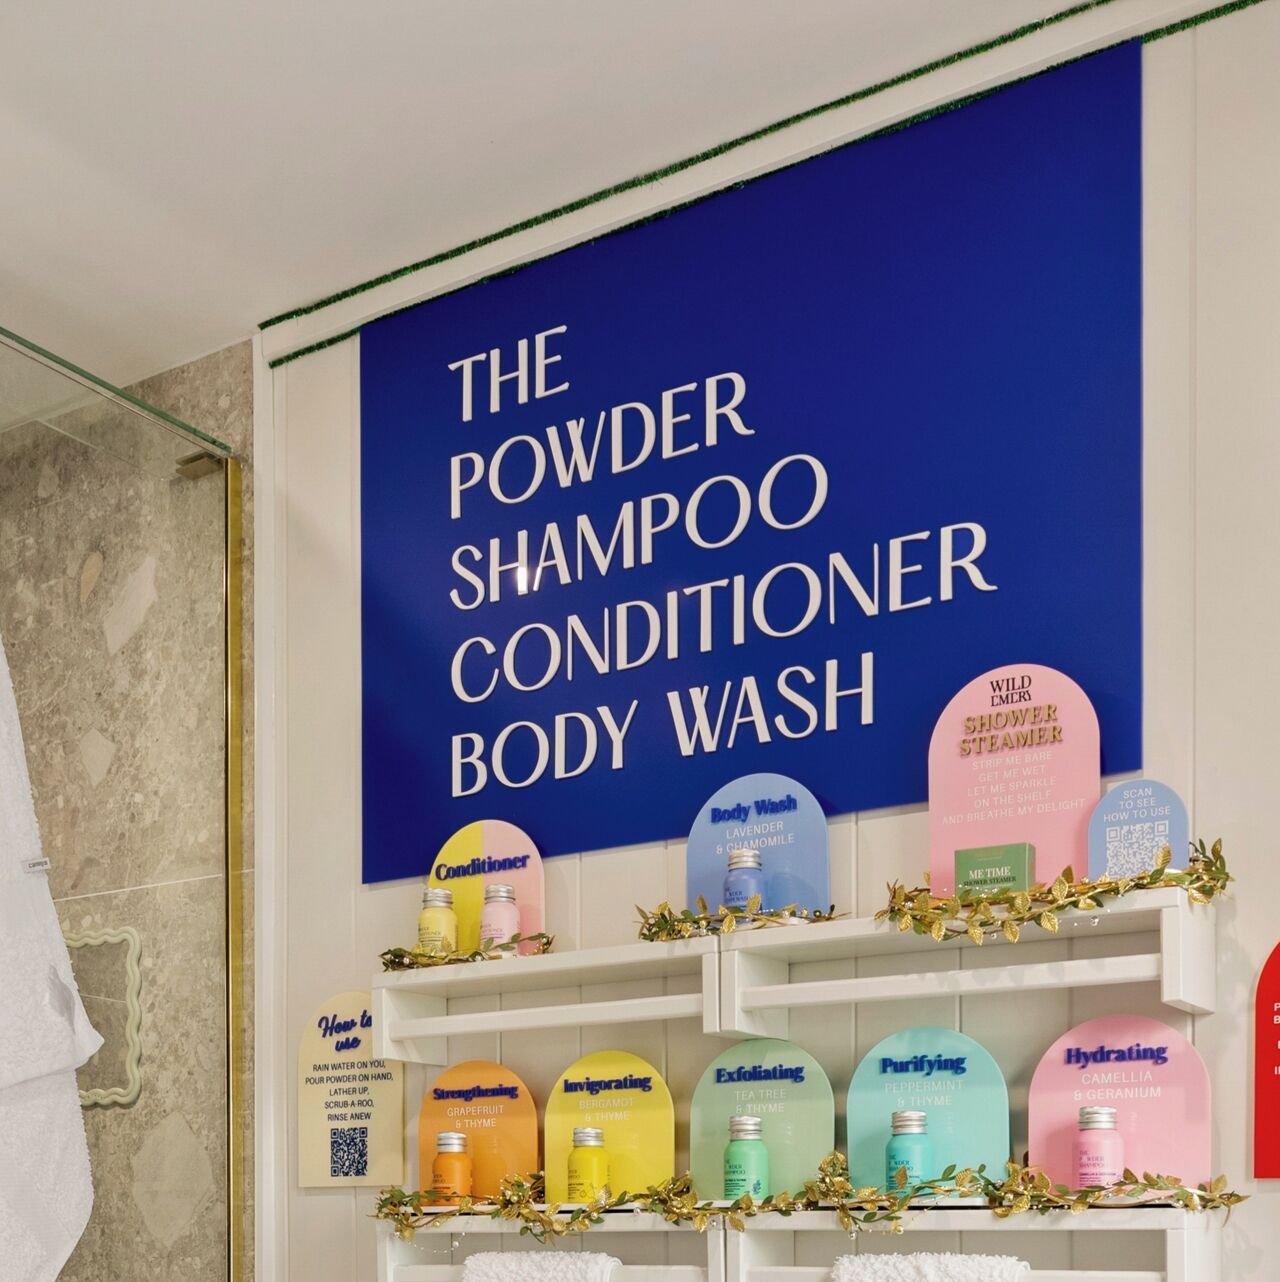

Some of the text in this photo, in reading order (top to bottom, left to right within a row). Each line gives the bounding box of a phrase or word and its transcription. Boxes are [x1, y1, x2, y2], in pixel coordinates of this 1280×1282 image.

[449, 325, 570, 422] THE
[451, 372, 755, 519] POWDER
[451, 454, 828, 611] SHAMPOO
[451, 522, 997, 703] CONDITIONER
[990, 675, 1032, 694] WILD
[451, 652, 875, 797] BODY WASH
[964, 703, 1058, 735] SHOWER
[959, 725, 1063, 757] STEAMER
[972, 751, 1053, 770] STRIP ME BARE
[979, 765, 1045, 783] GET ME WET
[968, 778, 1056, 797] LET ME SPARKLE
[1123, 787, 1152, 799] SCAN
[974, 790, 1052, 808] ON THE SHELF
[1119, 798, 1156, 810] TO SEE
[711, 794, 797, 824] Body Wash
[942, 799, 1086, 825] AND BREATHE MY DELIGHT
[1104, 806, 1171, 823] HOW TO USE
[726, 821, 784, 839] LAVENDER
[716, 833, 795, 855] & CHAMOMILE
[435, 852, 530, 882] Conditioner
[969, 866, 1011, 880] ME TIME
[318, 1014, 357, 1038] How
[335, 1036, 361, 1052] use
[1065, 1043, 1168, 1068] Hydrating
[313, 1063, 329, 1072] RAIN
[330, 1061, 355, 1071] WATER
[356, 1060, 368, 1069] ON
[715, 1063, 806, 1085] Exfoliating
[880, 1053, 967, 1078] Purifying
[305, 1076, 324, 1085] POUR
[326, 1074, 357, 1084] POWDER
[358, 1073, 369, 1082] ON
[563, 1074, 651, 1096] Invigorating
[884, 1080, 963, 1093] PEPPERMINT
[1080, 1070, 1153, 1086] CAMELLIA
[329, 1087, 357, 1096] LATHER
[433, 1084, 519, 1102] Strengthening
[735, 1088, 786, 1101] TEA TREE
[1073, 1085, 1162, 1101] & GERANIUM
[447, 1104, 505, 1117] GRAPEFRUIT
[579, 1098, 635, 1110] BERGAMOT
[735, 1102, 785, 1113] & THYME
[897, 1096, 952, 1107] & THYME
[327, 1112, 372, 1122] RINSE ANEW
[455, 1118, 497, 1129] & THYME
[595, 1111, 630, 1121] THYME
